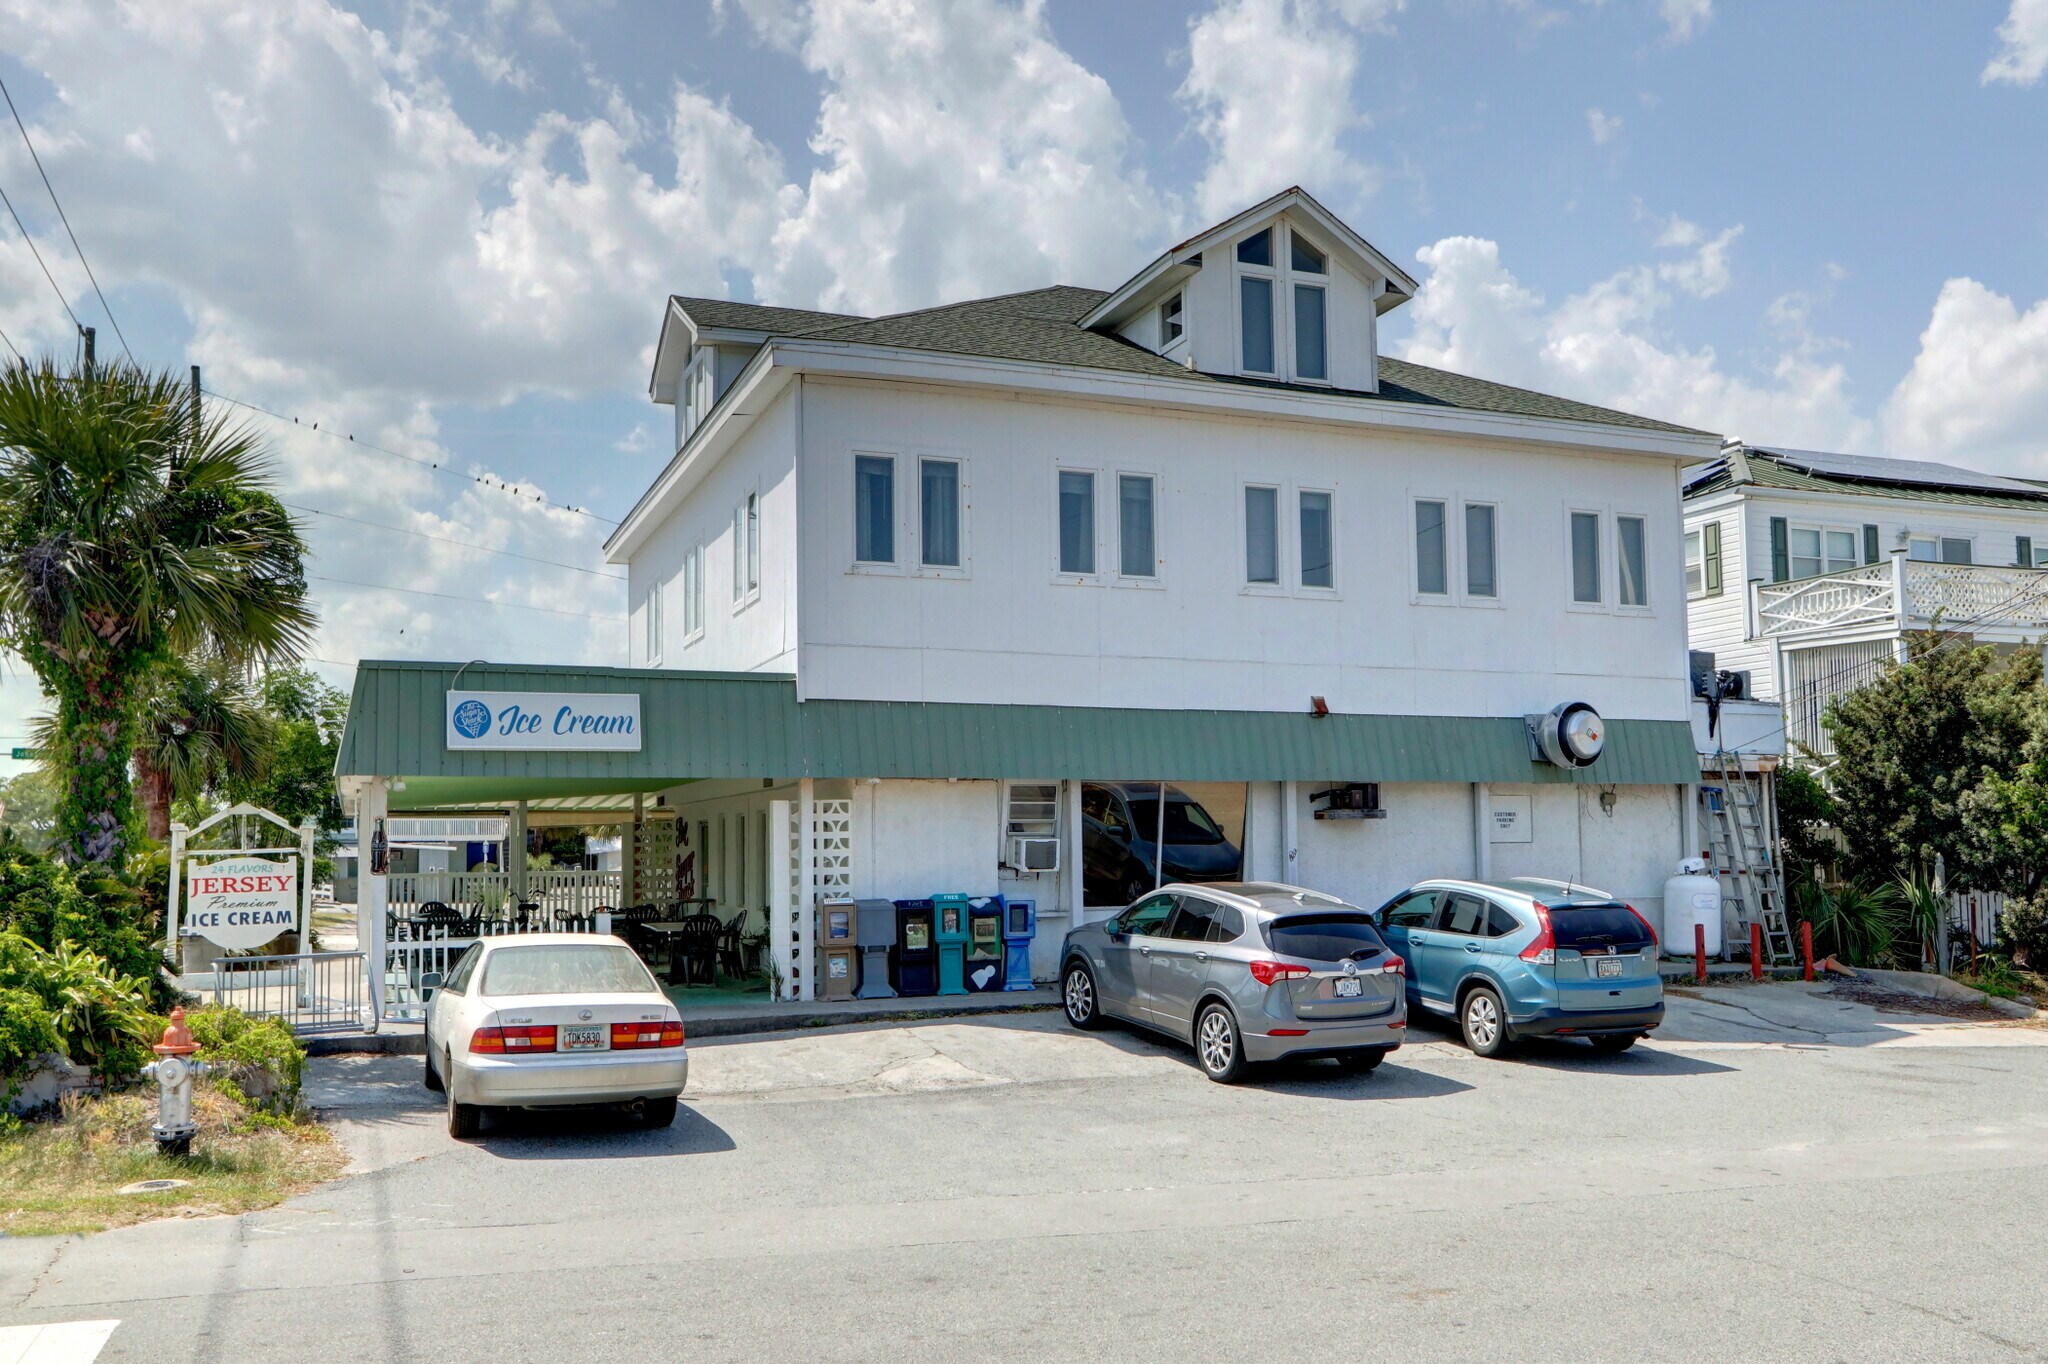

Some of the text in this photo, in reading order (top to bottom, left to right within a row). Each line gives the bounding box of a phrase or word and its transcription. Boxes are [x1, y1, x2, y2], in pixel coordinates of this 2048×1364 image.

[499, 705, 635, 736] Ice Cream
[212, 864, 274, 874] 24 FLAVORS
[191, 876, 294, 898] JERSEY
[207, 895, 278, 909] Premium
[191, 910, 292, 927] ICE CREAM
